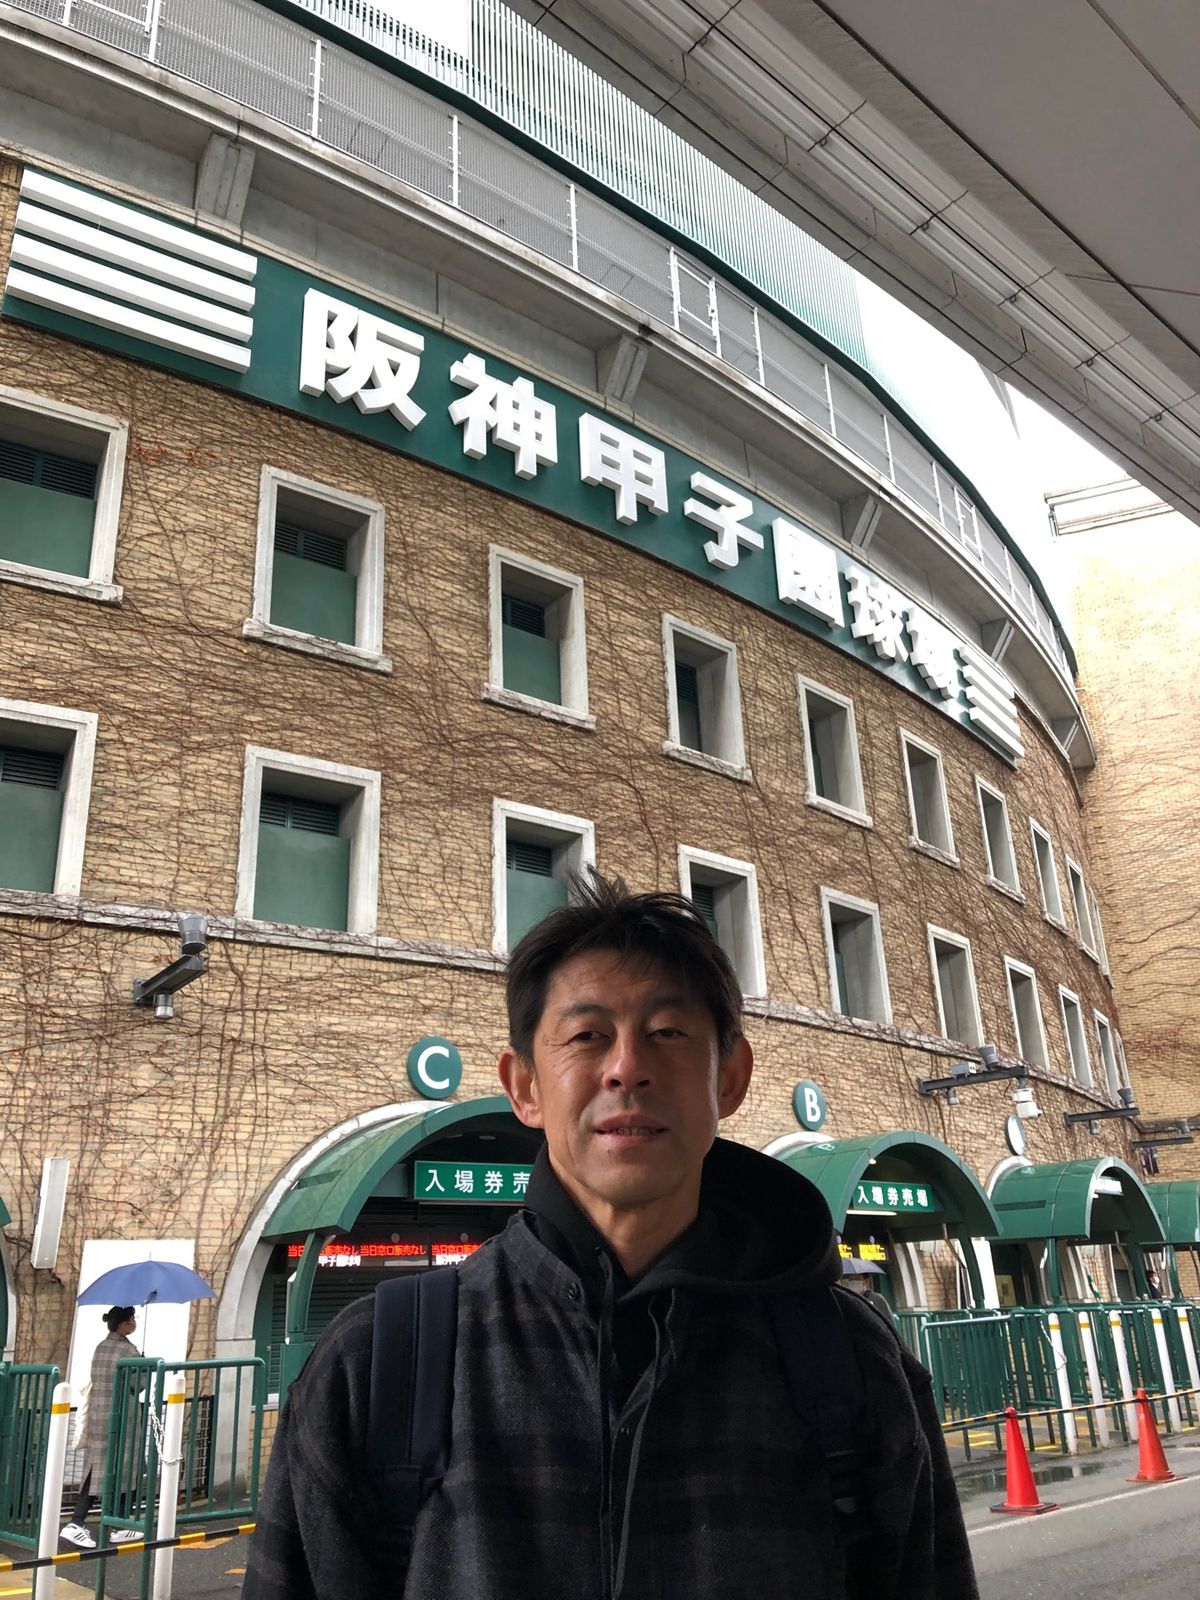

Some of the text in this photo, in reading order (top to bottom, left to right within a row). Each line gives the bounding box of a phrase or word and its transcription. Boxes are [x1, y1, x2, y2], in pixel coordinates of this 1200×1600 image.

[417, 1045, 450, 1090] C
[804, 1087, 821, 1122] B
[425, 1169, 531, 1194] 入場券売
[288, 1245, 357, 1257] 当日販売なし
